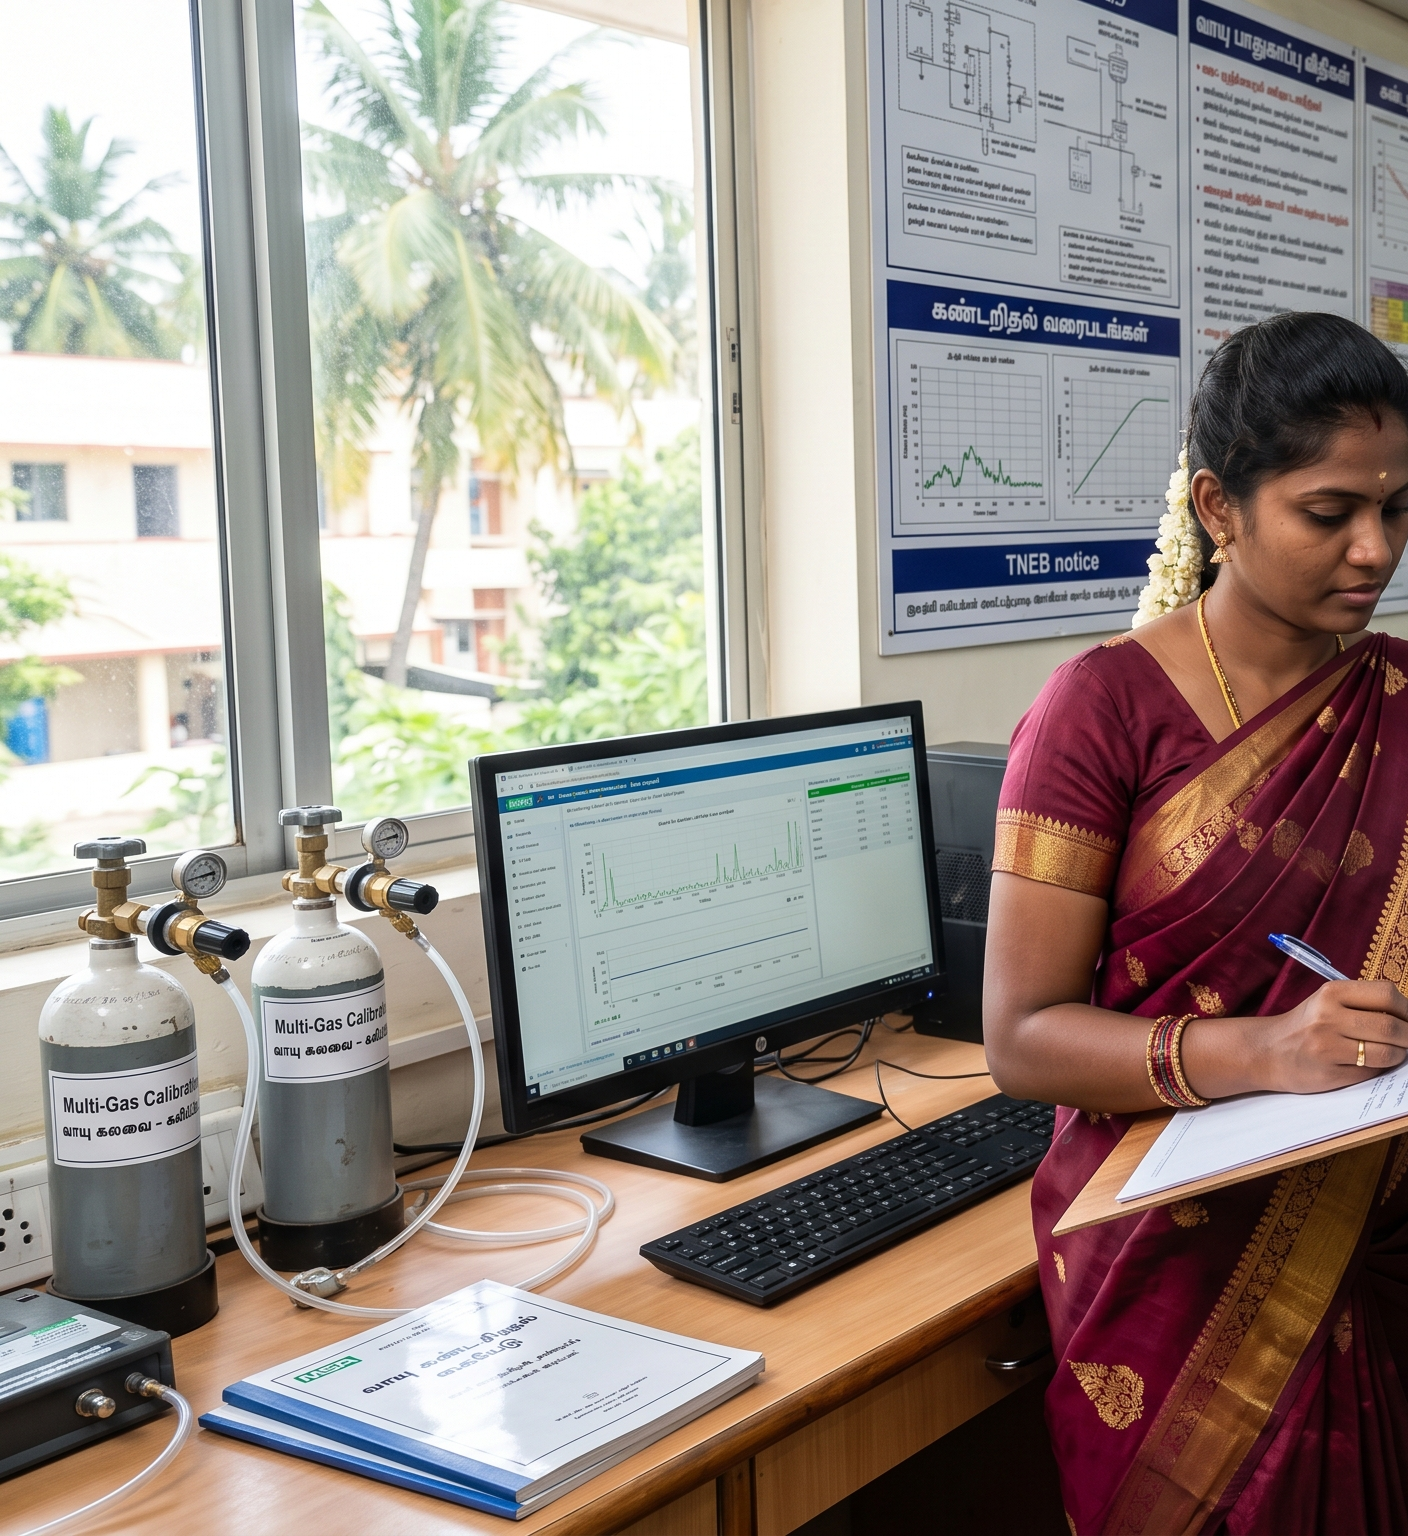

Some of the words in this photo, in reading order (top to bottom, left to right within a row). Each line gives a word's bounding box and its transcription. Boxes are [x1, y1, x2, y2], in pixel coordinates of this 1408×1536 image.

[1196, 15, 1231, 48] வாயு
[1234, 29, 1302, 73] பாதுகாப்பு
[1304, 52, 1350, 87] விதிகள்
[931, 297, 1038, 335] கண்டறிதல்
[1043, 317, 1150, 343] வரைபடங்கள்
[1005, 552, 1051, 576] TNEB
[1055, 551, 1100, 573] notice
[275, 1017, 343, 1035] Multi-Gas
[274, 1046, 301, 1059] வாயு
[305, 1040, 353, 1056] கலவை
[63, 1096, 139, 1114] Multi-Gas
[63, 1126, 91, 1141] வாயு
[96, 1120, 152, 1137] கலவை
[298, 1358, 361, 1381] MSA
[362, 1370, 420, 1394] வாயு
